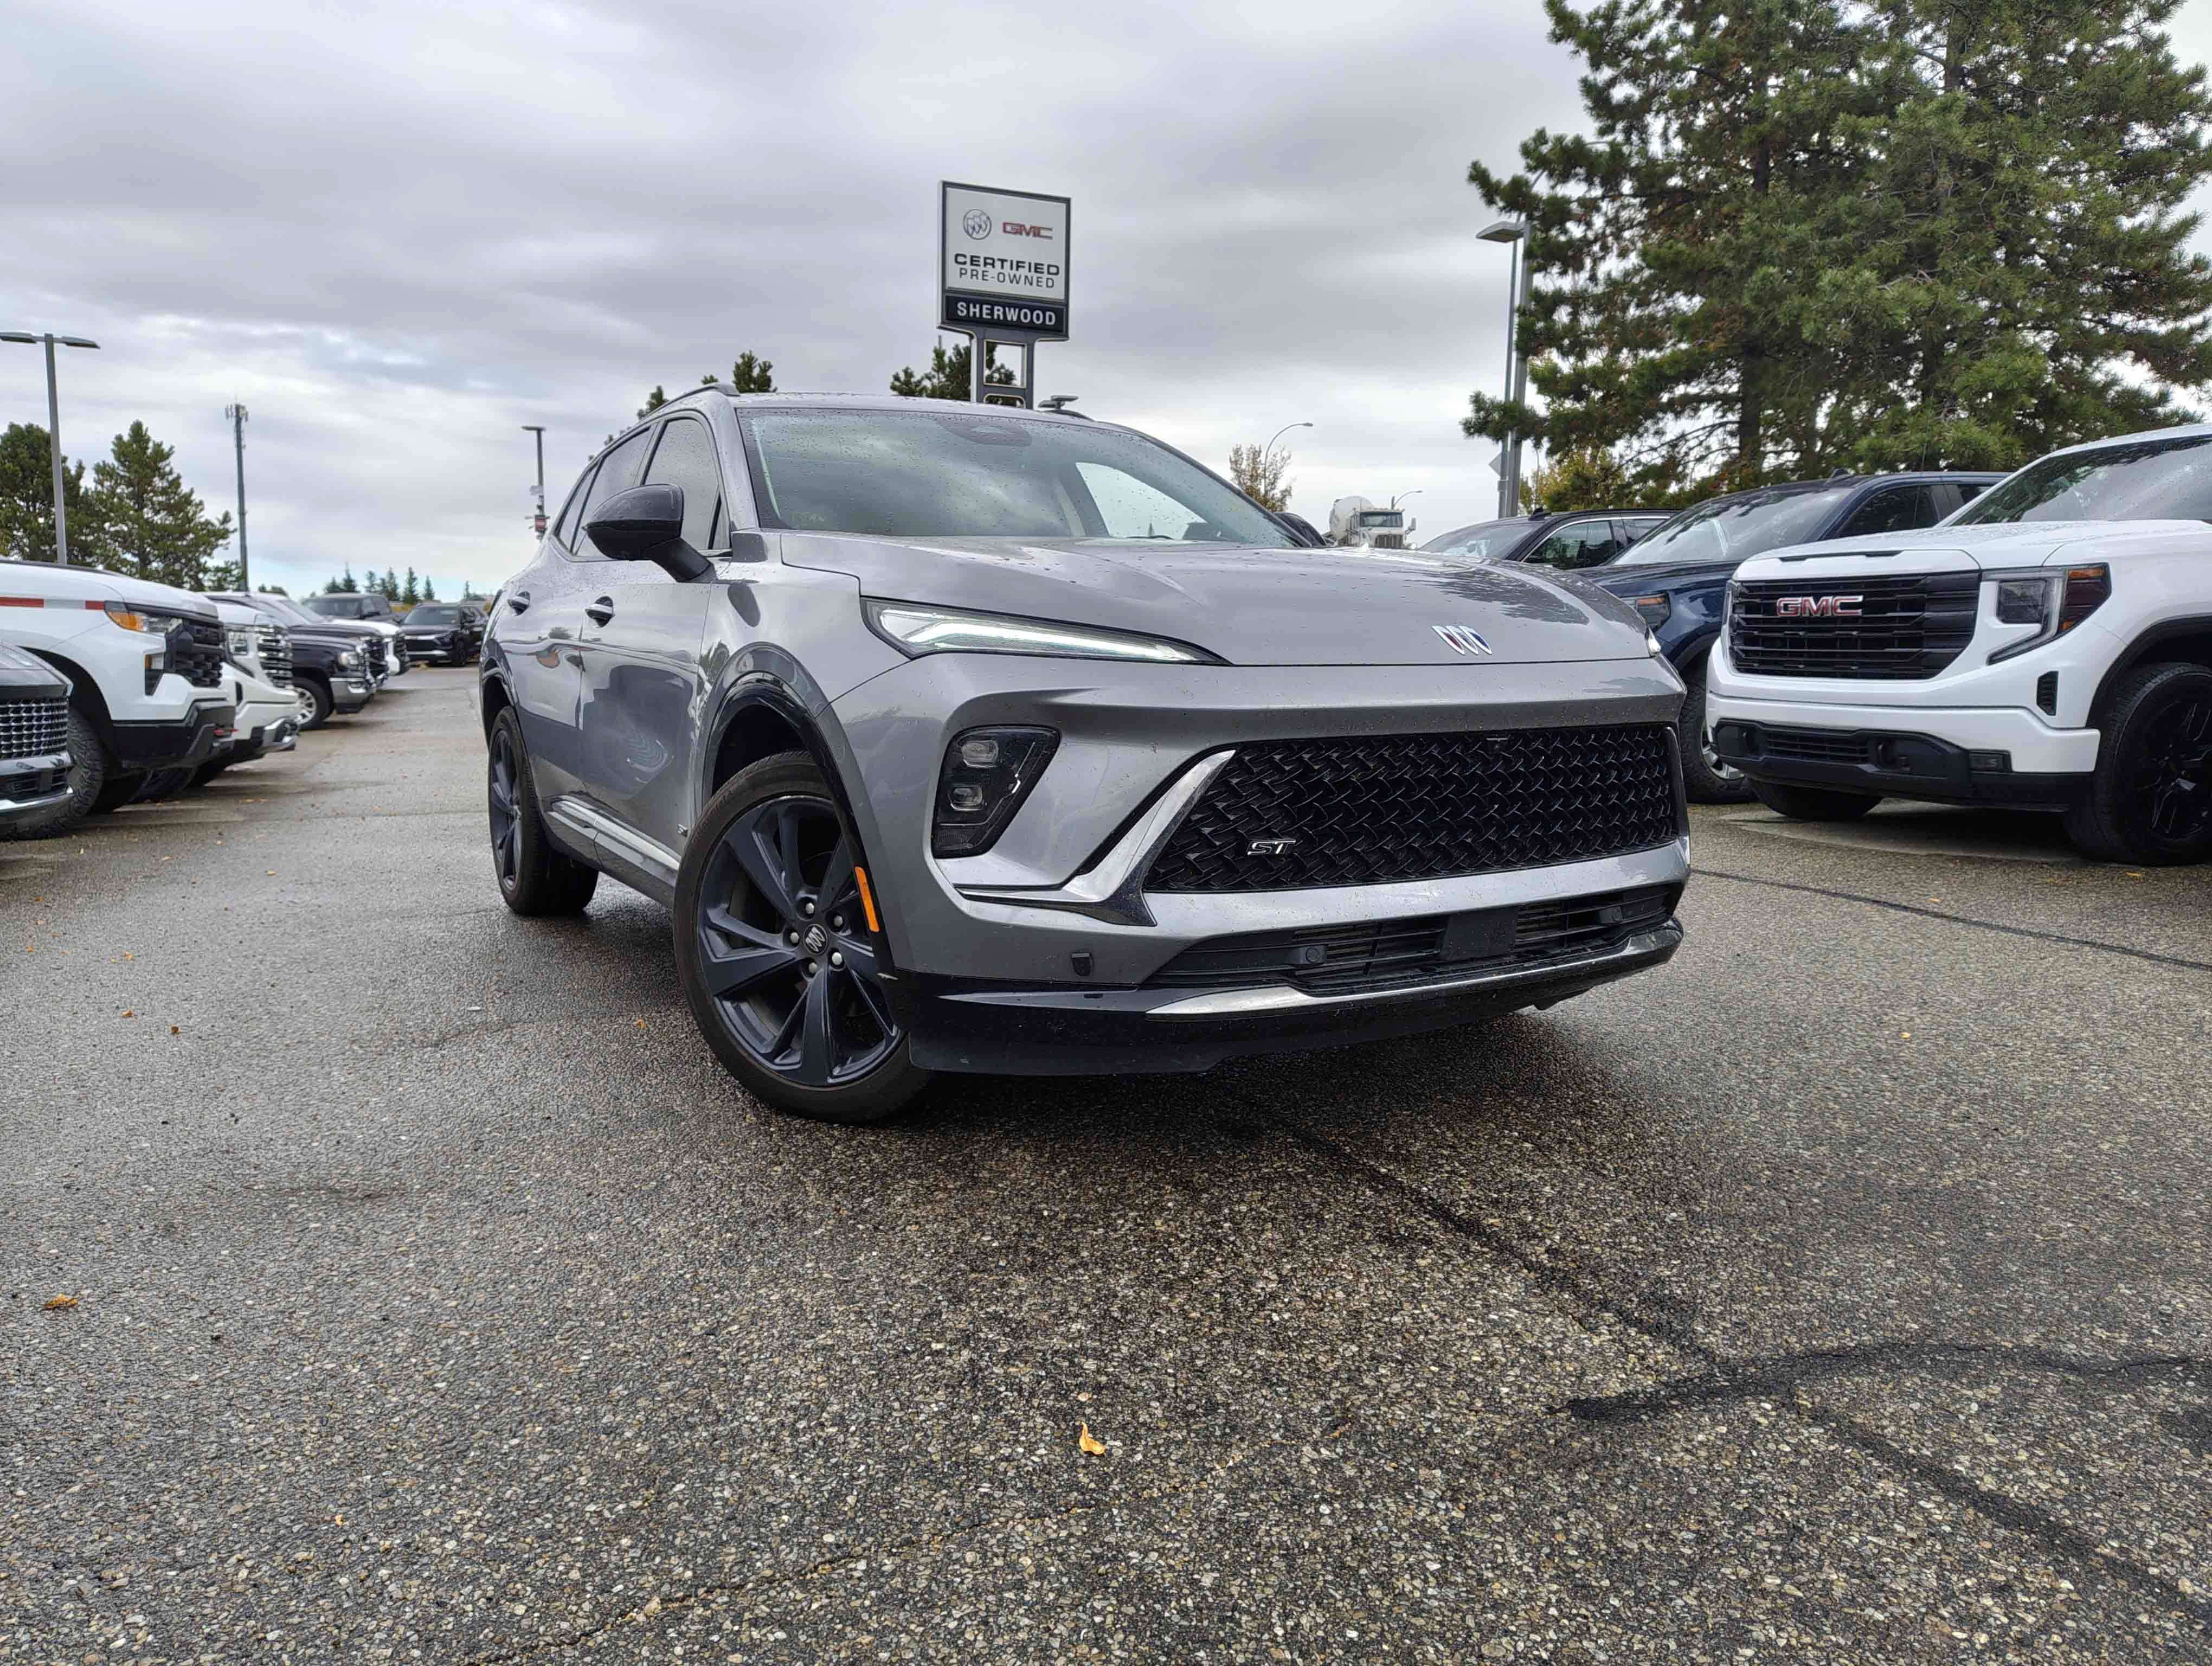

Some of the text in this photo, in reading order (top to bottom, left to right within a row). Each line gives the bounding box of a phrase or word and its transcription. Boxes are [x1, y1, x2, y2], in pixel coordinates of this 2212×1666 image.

[1002, 222, 1053, 240] GMC
[954, 253, 1060, 276] CERTIFIED
[959, 267, 1054, 289] PRE-OWNED
[956, 302, 1056, 325] SHERWOOD
[1777, 595, 1863, 617] GMC
[1246, 838, 1296, 855] ST
